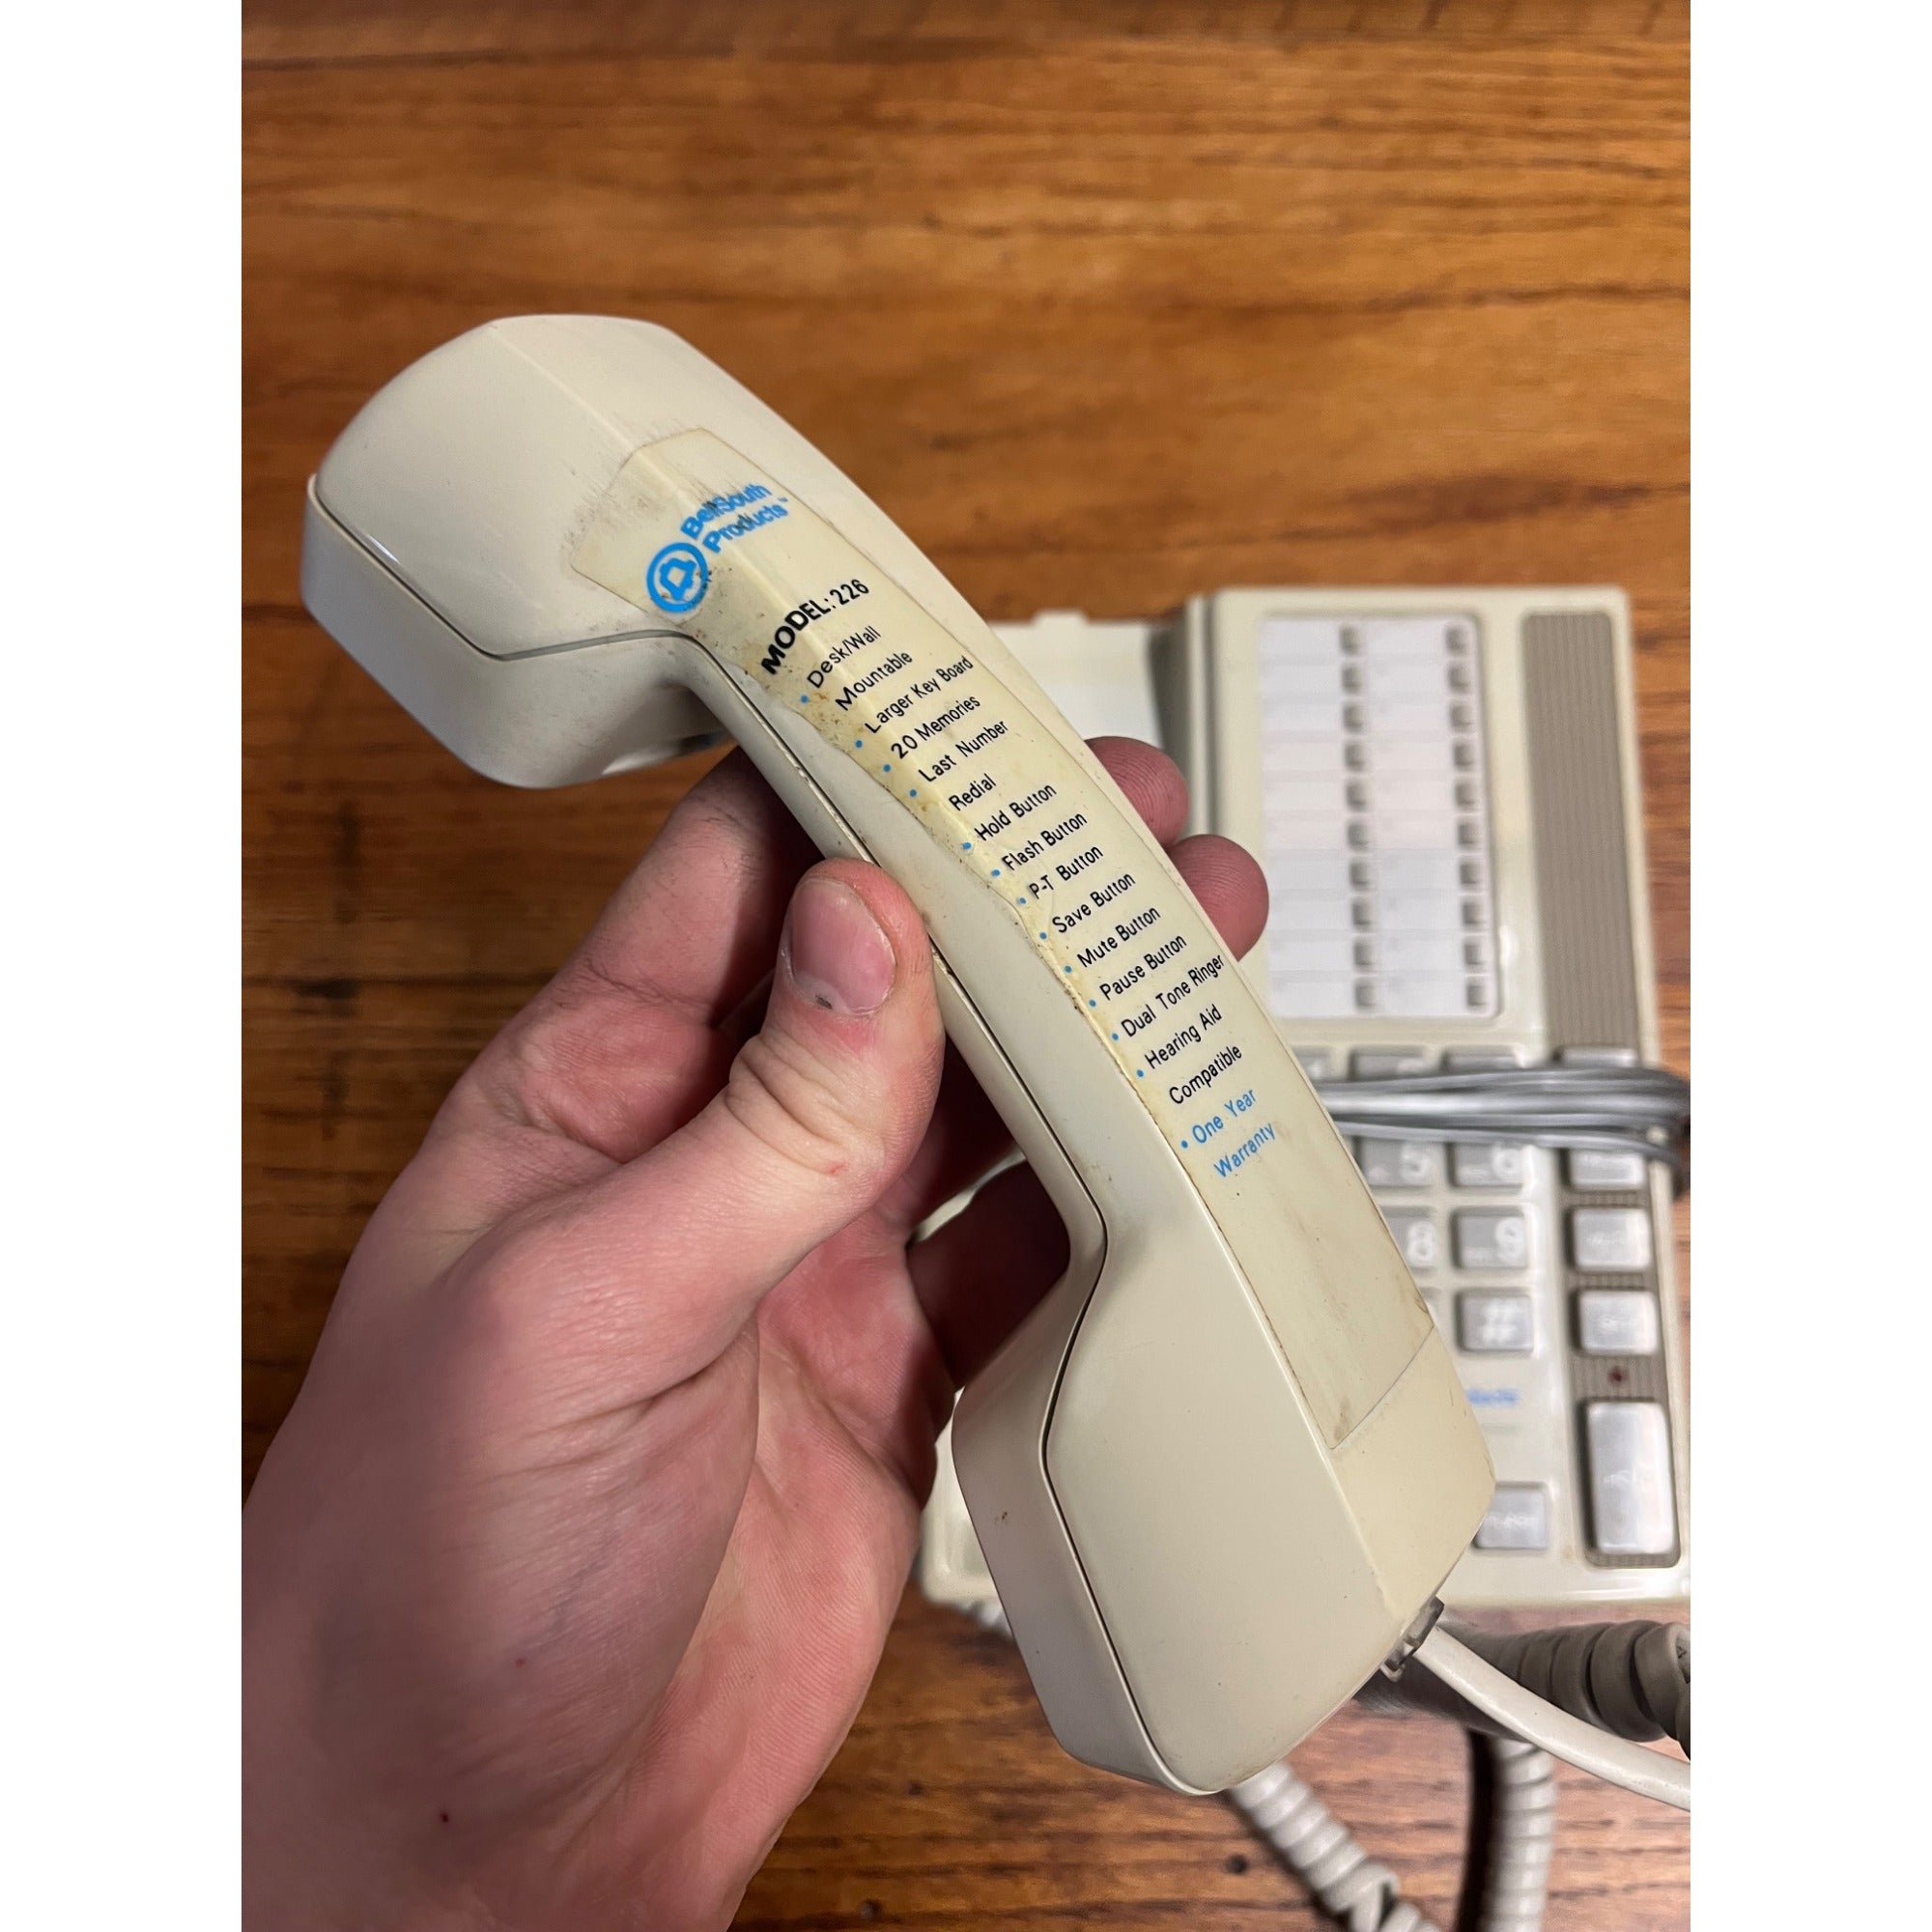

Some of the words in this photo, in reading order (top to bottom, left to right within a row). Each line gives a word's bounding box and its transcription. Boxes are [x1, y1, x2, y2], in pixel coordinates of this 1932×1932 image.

[680, 483, 772, 540] BellSouth
[807, 625, 881, 688] Desk/Wall
[835, 650, 913, 711] Mountable
[865, 693, 914, 734] Larger
[910, 678, 941, 698] Key
[935, 655, 974, 683] Board
[891, 734, 919, 759] 20
[914, 695, 980, 742] Memories
[918, 753, 957, 783] Last
[954, 720, 1009, 757] Number
[948, 773, 997, 811] Redial
[974, 810, 1011, 841] Hold
[1009, 784, 1057, 818] Button
[1001, 840, 1044, 870] Flash
[1040, 813, 1088, 846] Button
[1055, 846, 1103, 881] Button
[1052, 904, 1092, 933] Save
[1090, 873, 1136, 908] Button
[1076, 936, 1118, 968] Mute
[1115, 907, 1161, 942] Button
[1099, 965, 1146, 1001] Pause
[1144, 935, 1187, 970] Button
[1121, 1004, 1157, 1037] Dual
[1155, 981, 1191, 1009] Tone
[1188, 954, 1224, 986] Ringer
[1144, 1025, 1202, 1069] Hearing
[1199, 1003, 1223, 1031] Aid
[1169, 1044, 1242, 1104] Compatible
[1192, 1116, 1224, 1144] One
[1224, 1090, 1257, 1118] Year
[1213, 1122, 1276, 1178] Warranty
[1406, 1220, 1436, 1268] 8
[1495, 1217, 1525, 1262] 9
